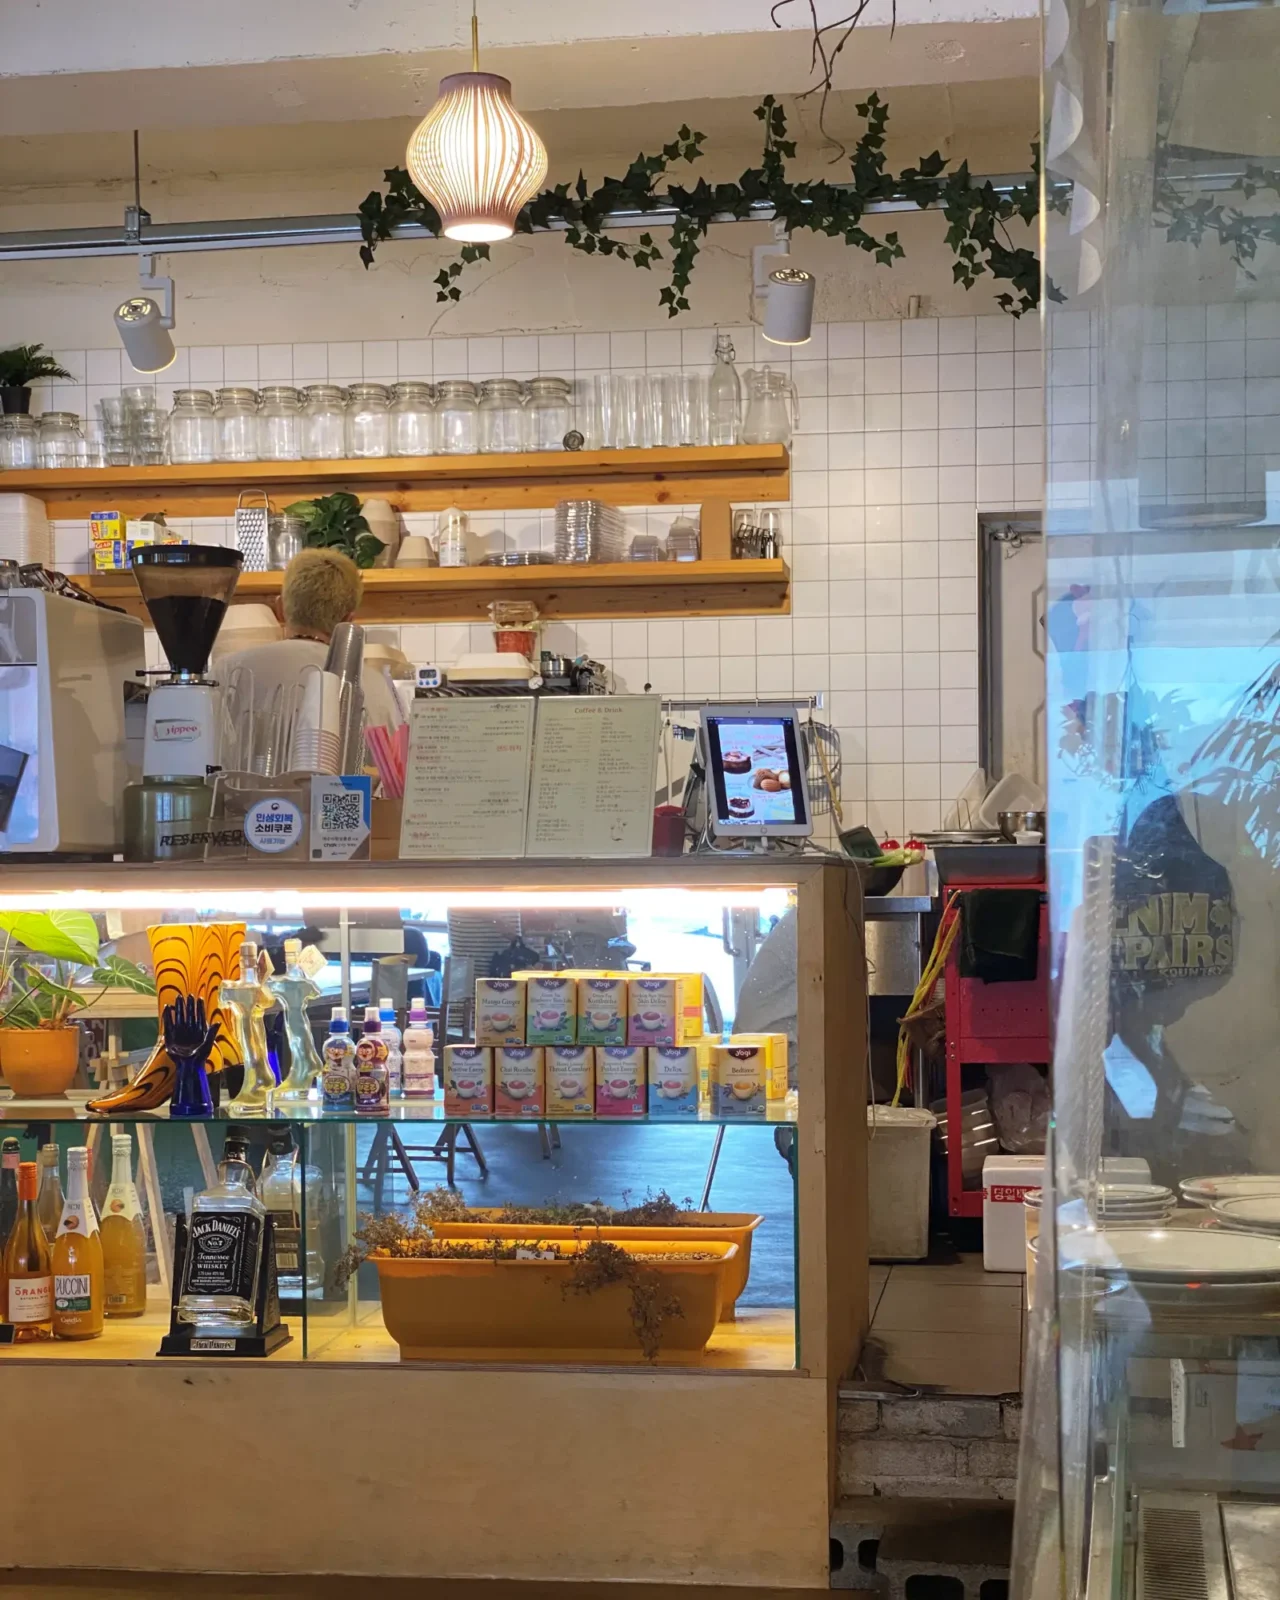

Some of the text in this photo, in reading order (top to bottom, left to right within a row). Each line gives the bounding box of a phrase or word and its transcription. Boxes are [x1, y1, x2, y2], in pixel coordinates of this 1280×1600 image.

[256, 813, 294, 823] 민생회복
[255, 823, 292, 833] 소비쿠폰
[192, 1219, 242, 1239] JACK DANIEL'S
[197, 1252, 230, 1260] Tennessee
[55, 1277, 88, 1296] PUCCINI
